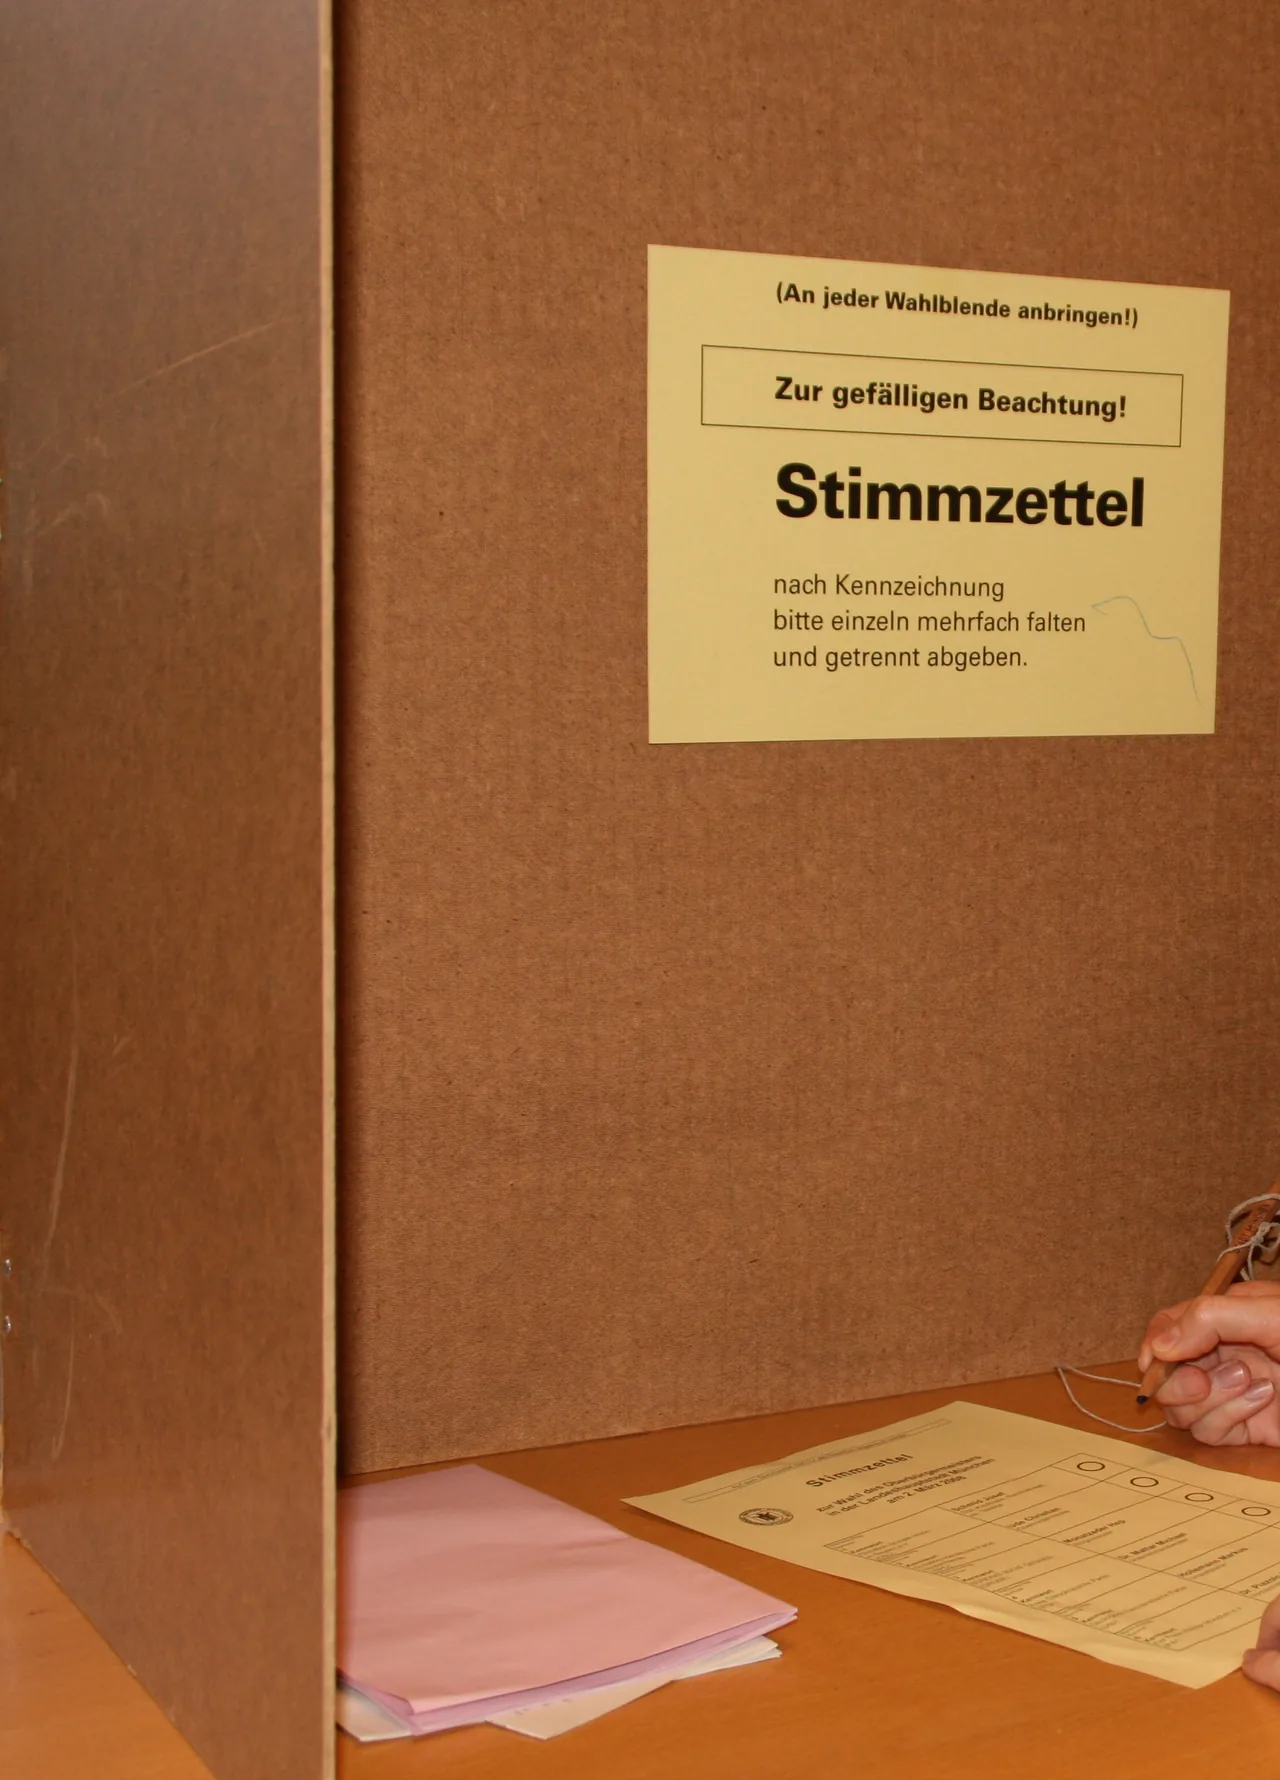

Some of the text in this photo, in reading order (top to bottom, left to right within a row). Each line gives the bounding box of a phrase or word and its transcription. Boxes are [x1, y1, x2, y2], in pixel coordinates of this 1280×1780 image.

[776, 281, 1138, 329] (An jeder Wahlblende anbringen!)
[774, 375, 1126, 423] Zur gefälligen Beachtung!
[775, 462, 1145, 528] Stimmzettel
[774, 573, 1004, 603] nach Kennzeichnung
[774, 608, 1086, 632] bitte einzeln mehrfach falten
[773, 645, 1027, 673] und getrennt abgeben.
[806, 1454, 913, 1487] Stimmzettel
[816, 1504, 834, 1512] zur
[832, 1493, 861, 1505] Wahl
[863, 1486, 884, 1494] des
[840, 1504, 859, 1512] der
